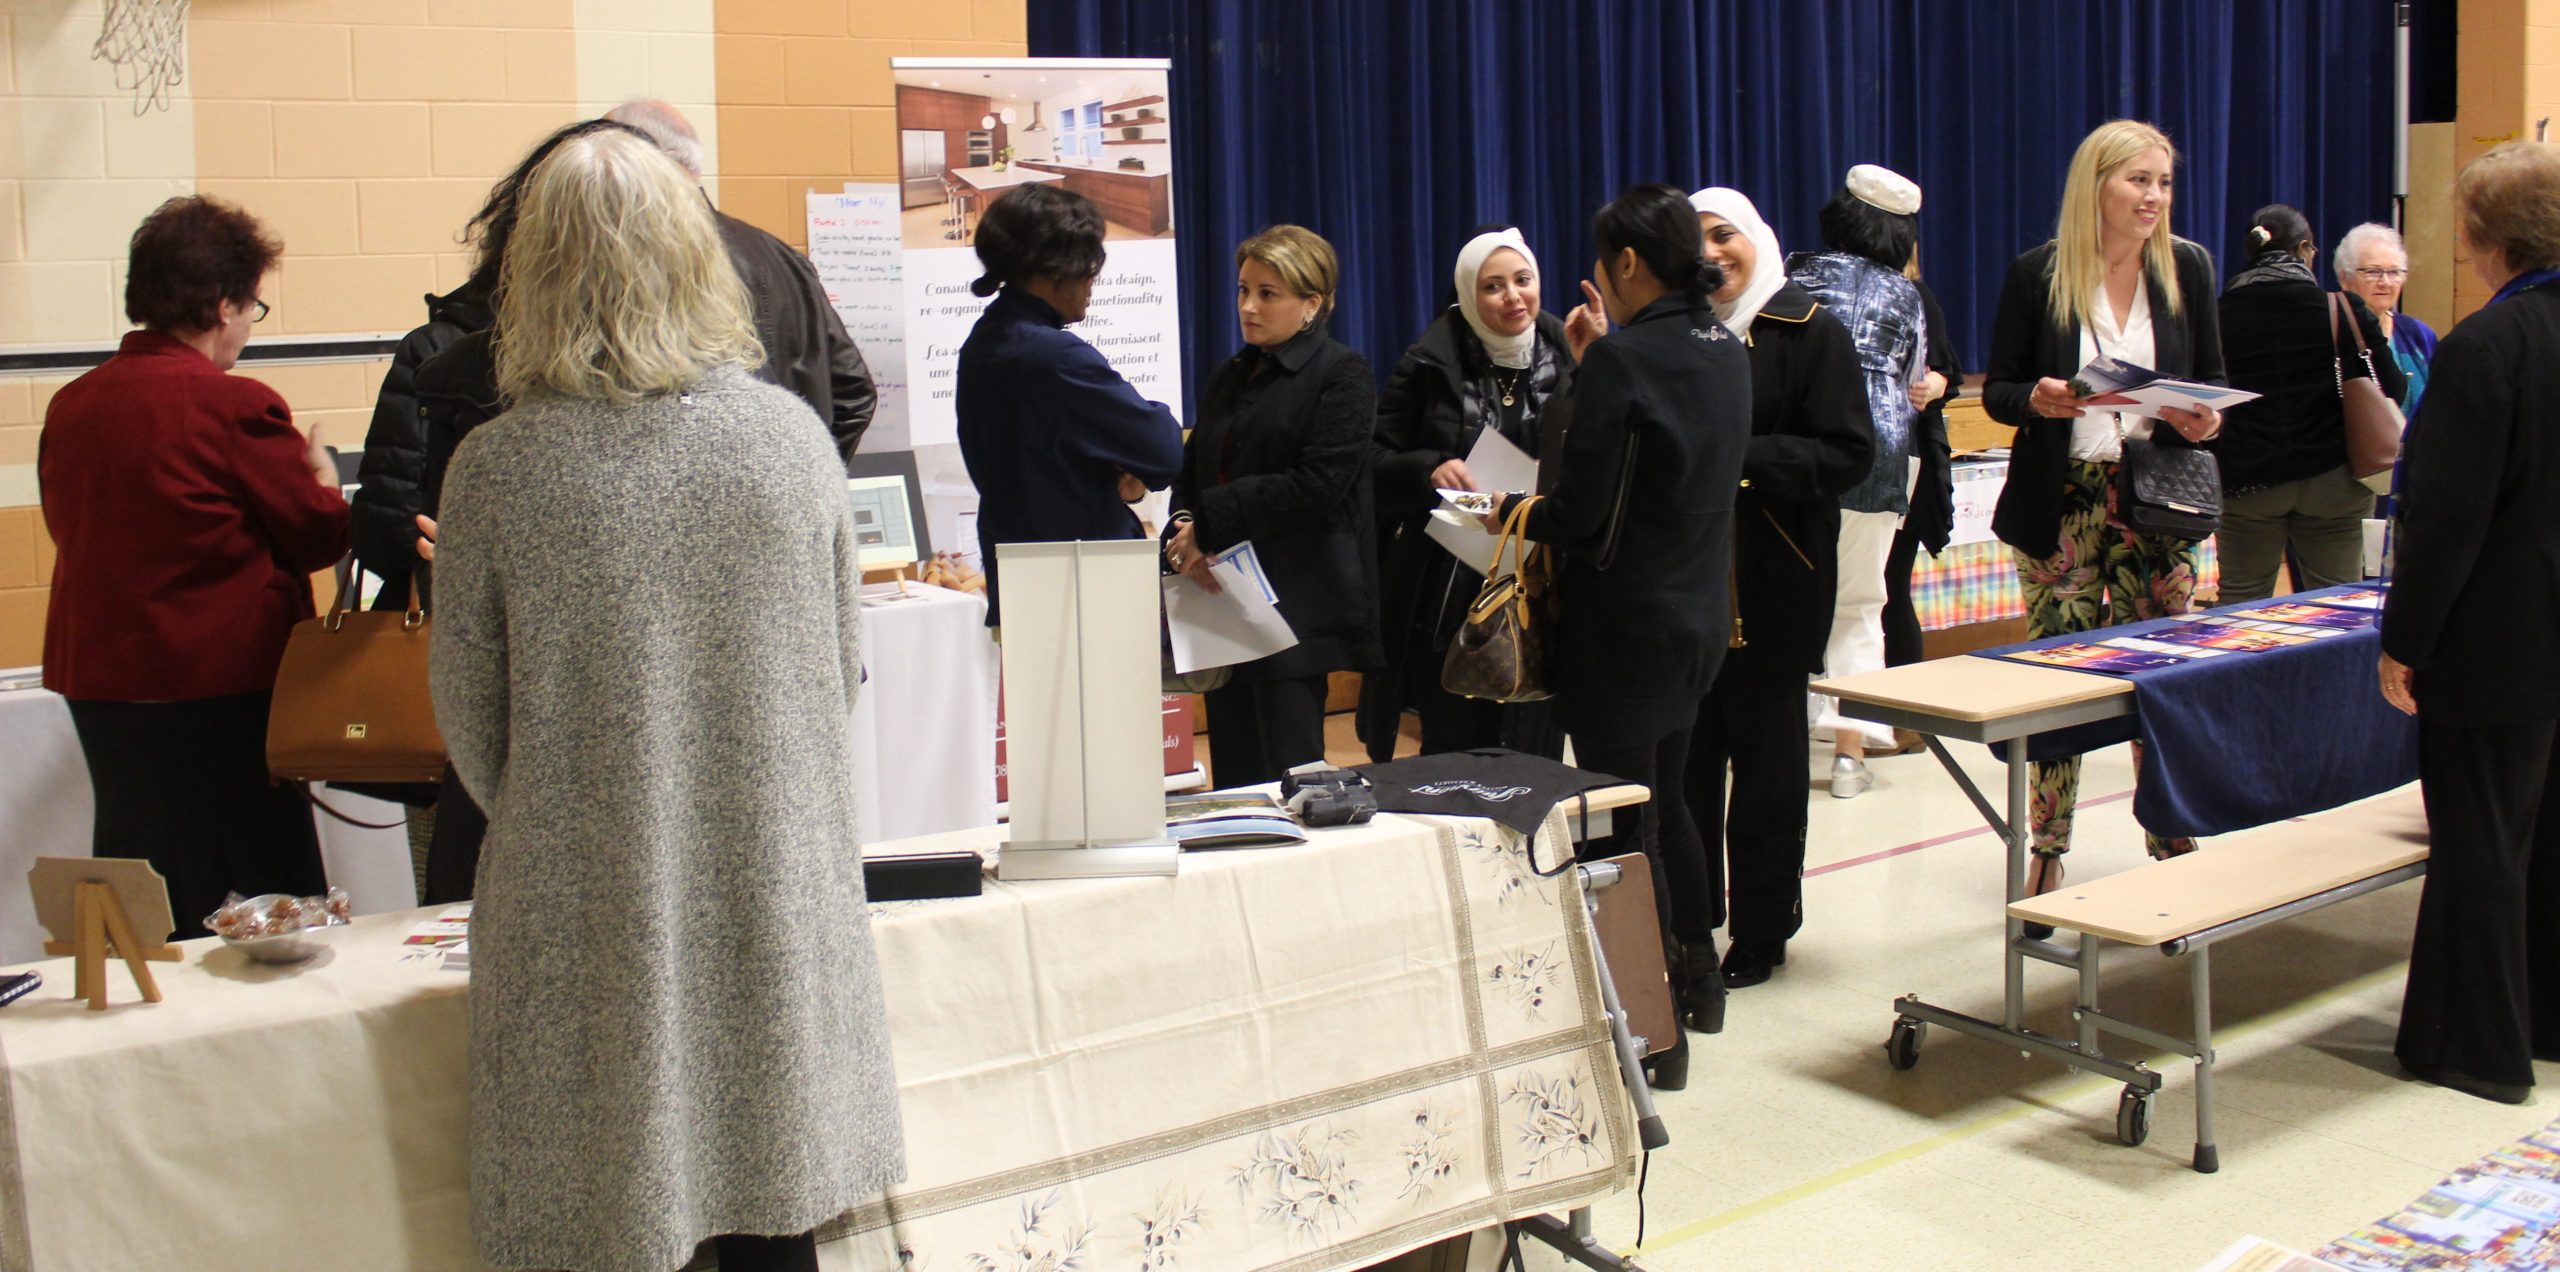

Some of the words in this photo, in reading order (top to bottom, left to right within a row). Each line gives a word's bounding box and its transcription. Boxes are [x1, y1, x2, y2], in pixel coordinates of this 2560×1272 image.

[919, 301, 983, 317] re-organi
[1091, 292, 1164, 307] unctionality
[1078, 315, 1114, 329] office.
[1096, 332, 1162, 347] fournissent
[929, 367, 952, 379] une
[1105, 352, 1145, 366] isation
[1147, 352, 1159, 363] et
[932, 388, 954, 399] une
